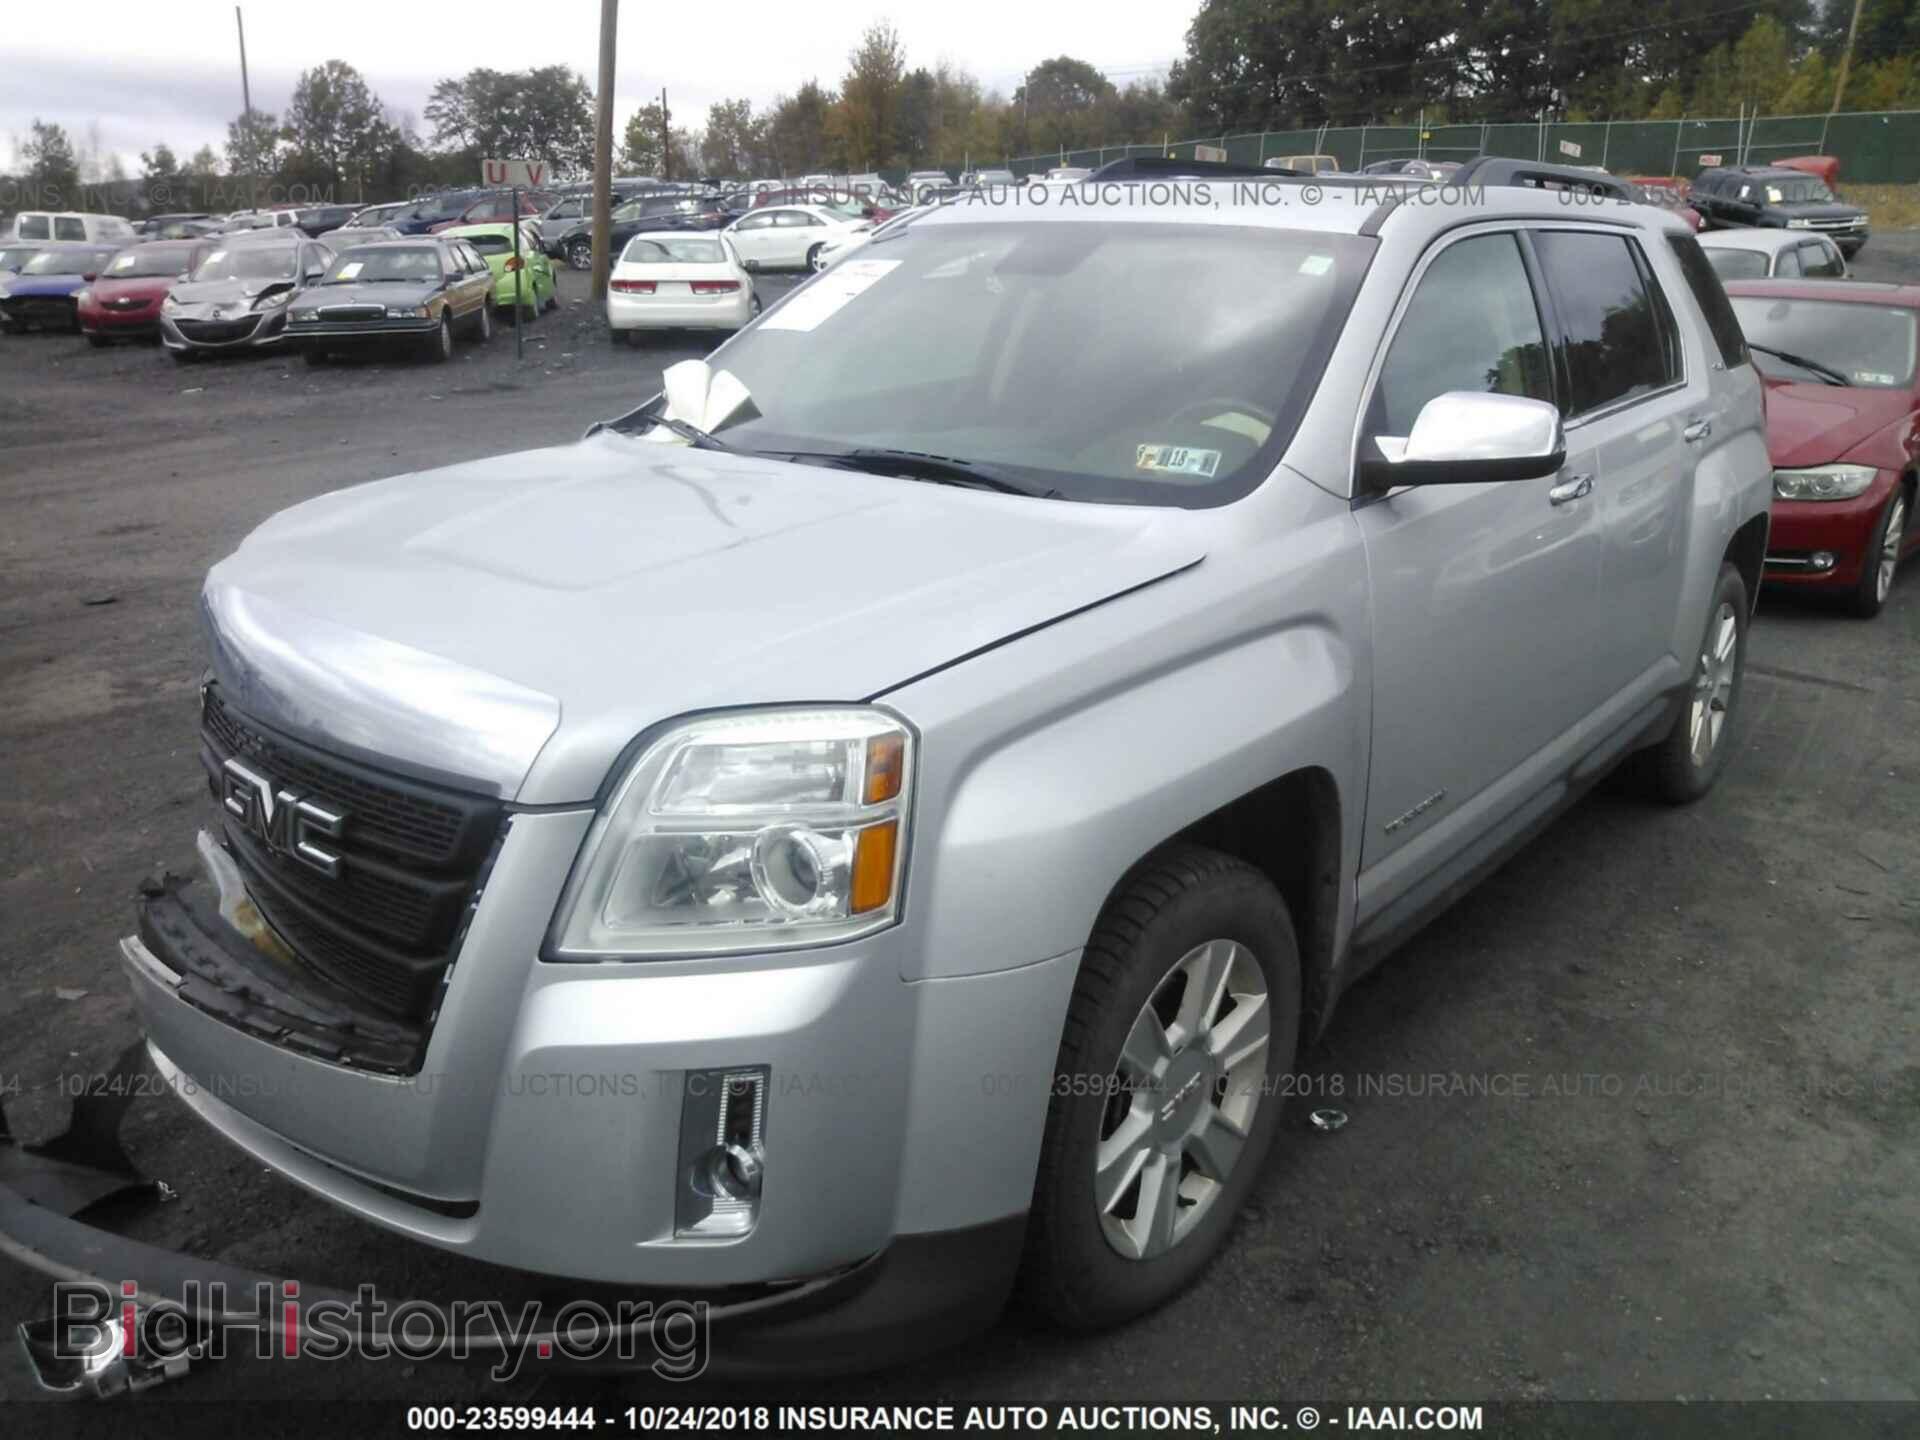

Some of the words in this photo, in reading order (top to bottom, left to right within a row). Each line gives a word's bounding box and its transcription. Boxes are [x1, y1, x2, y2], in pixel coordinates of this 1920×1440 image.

[487, 162, 508, 185] U
[525, 163, 544, 184] V
[222, 758, 343, 880] GMC
